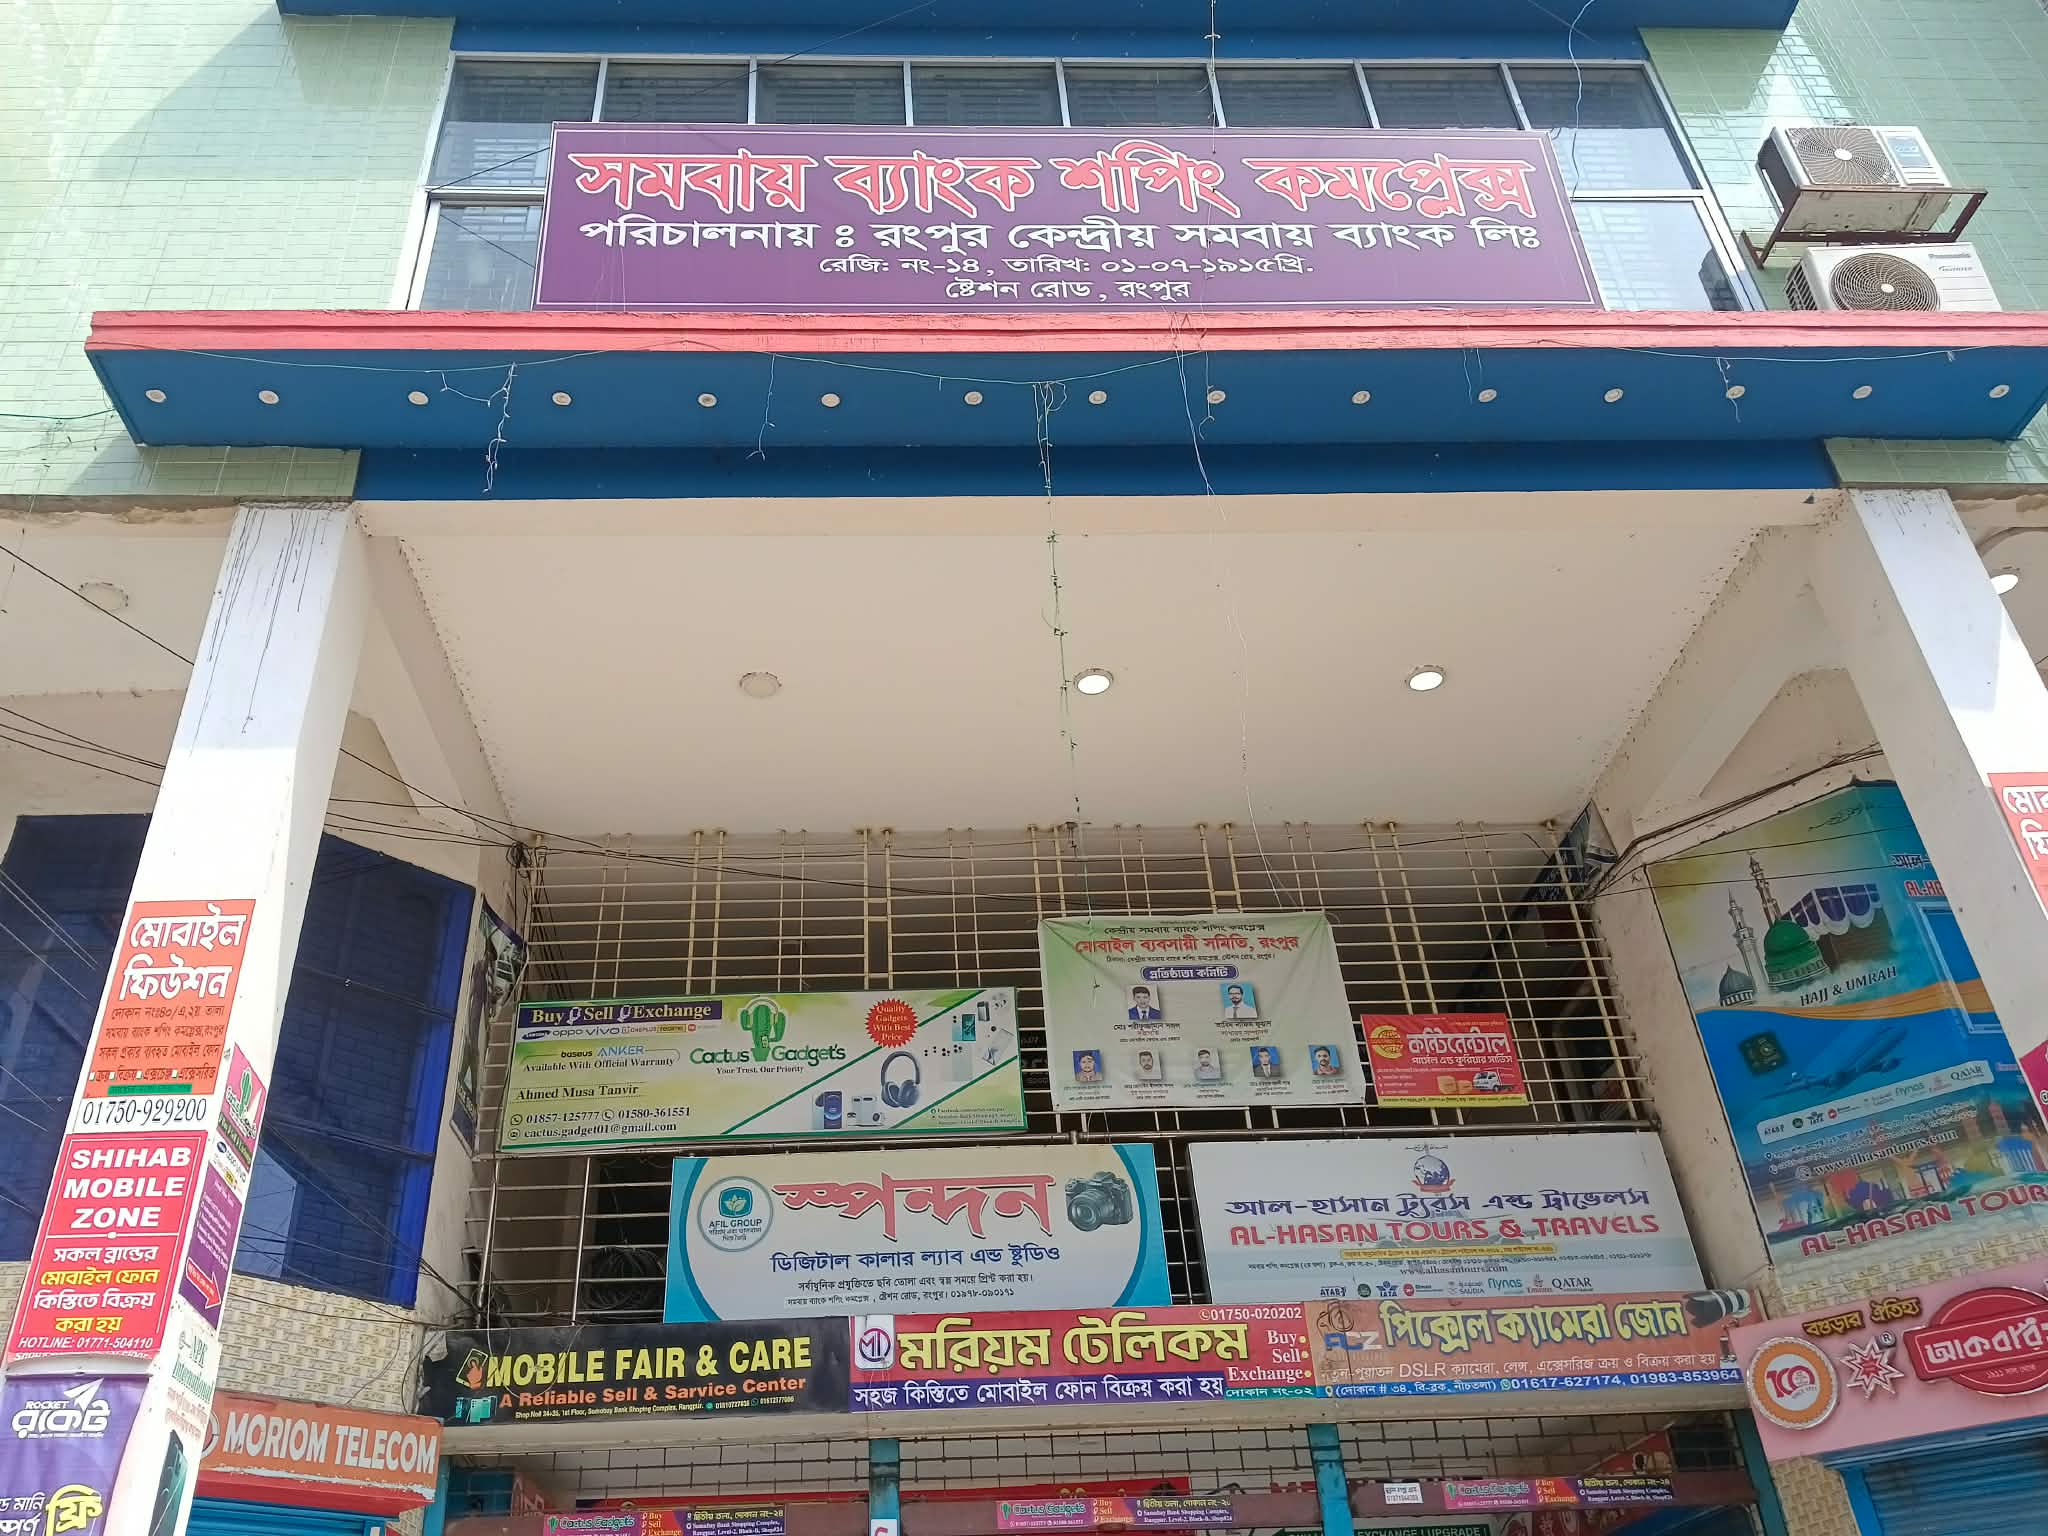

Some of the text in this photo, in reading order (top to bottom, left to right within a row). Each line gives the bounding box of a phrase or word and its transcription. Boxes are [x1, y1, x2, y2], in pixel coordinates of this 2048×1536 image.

[568, 139, 1538, 218] সমবায় ব্যাংক শপিং কমপ্লেক্স
[579, 214, 822, 249] পরিচালনায়
[869, 222, 995, 256] রংপুর
[1008, 215, 1160, 253] কেন্দ্রীয়
[1166, 222, 1317, 249] সমবায়
[1331, 222, 1456, 251] ব্যাংক
[1466, 218, 1542, 249] লিঃ
[1113, 280, 1193, 303] রংপুর
[129, 903, 248, 952] মোবাইল
[1257, 934, 1300, 951] রংপুর
[119, 952, 233, 1001] ফিউশন
[1799, 966, 1898, 1008] HAJJ & UMRAH
[532, 1003, 712, 1025] Buy Sell Exchange
[585, 1026, 620, 1039] vivo
[597, 1045, 645, 1057] ANKER
[689, 1047, 750, 1064] Cactus
[523, 1058, 675, 1073] Available With Official Warranty
[516, 1084, 640, 1101] Ahmed Musa Tanvir
[82, 1098, 207, 1126] 01750-929200
[525, 1106, 691, 1125] 01857-125777 01580-361551
[70, 1147, 191, 1169] SHIHAB
[62, 1177, 186, 1199] MOBILE
[1224, 1195, 1390, 1216] আল-হাসান
[1482, 1194, 1533, 1209] এন্ড
[1537, 1187, 1650, 1212] ট্রাভেলস
[70, 1206, 161, 1229] ZONE
[709, 1218, 762, 1228] AFIL GROUP
[1230, 1213, 1661, 1246] AL-HASAN TOURS & TRAVELS
[1800, 1202, 1952, 1258] AL-HASAN
[53, 1247, 102, 1262] সকল
[770, 1250, 852, 1272] ডিজিটাল
[856, 1250, 916, 1268] কালার
[921, 1248, 964, 1266] ল্যাব
[970, 1247, 1003, 1265] এন্ড
[40, 1266, 161, 1286] মোবাইল ফোন
[1552, 1277, 1593, 1289] QATAR
[33, 1288, 156, 1310] কিস্তিতে বিক্রয়
[55, 1315, 124, 1334] করা হয়
[1211, 1307, 1303, 1320] 01750-020202
[1803, 1297, 1922, 1338] বগুড়ার ঐতিহ্য
[1378, 1299, 1688, 1353] পিক্সেল ক্যামেরা জোন
[18, 1336, 153, 1349] HOTLINE: 01771-504110
[896, 1311, 1250, 1374] মরিয়ম টেলিকম
[1267, 1329, 1298, 1347] Buy
[486, 1336, 813, 1388] MOBILE FAIR & CARE
[1272, 1349, 1302, 1364] Sell
[1399, 1362, 1447, 1378] DSLR
[1623, 1359, 1633, 1368] ও
[1673, 1354, 1696, 1366] করা
[1699, 1353, 1716, 1365] হয়
[1227, 1366, 1304, 1383] Exchange
[1630, 1368, 1740, 1385] 01983-853964
[499, 1376, 807, 1409] A Reliable Sell & Sarvice Center
[853, 1374, 1225, 1407] সহজ কিস্তিতে মোবাইল ফোন বিক্রয় করা হয়
[24, 1400, 70, 1410] ROCKET
[223, 1411, 330, 1464] MORIOM
[334, 1424, 438, 1474] TELECOM
